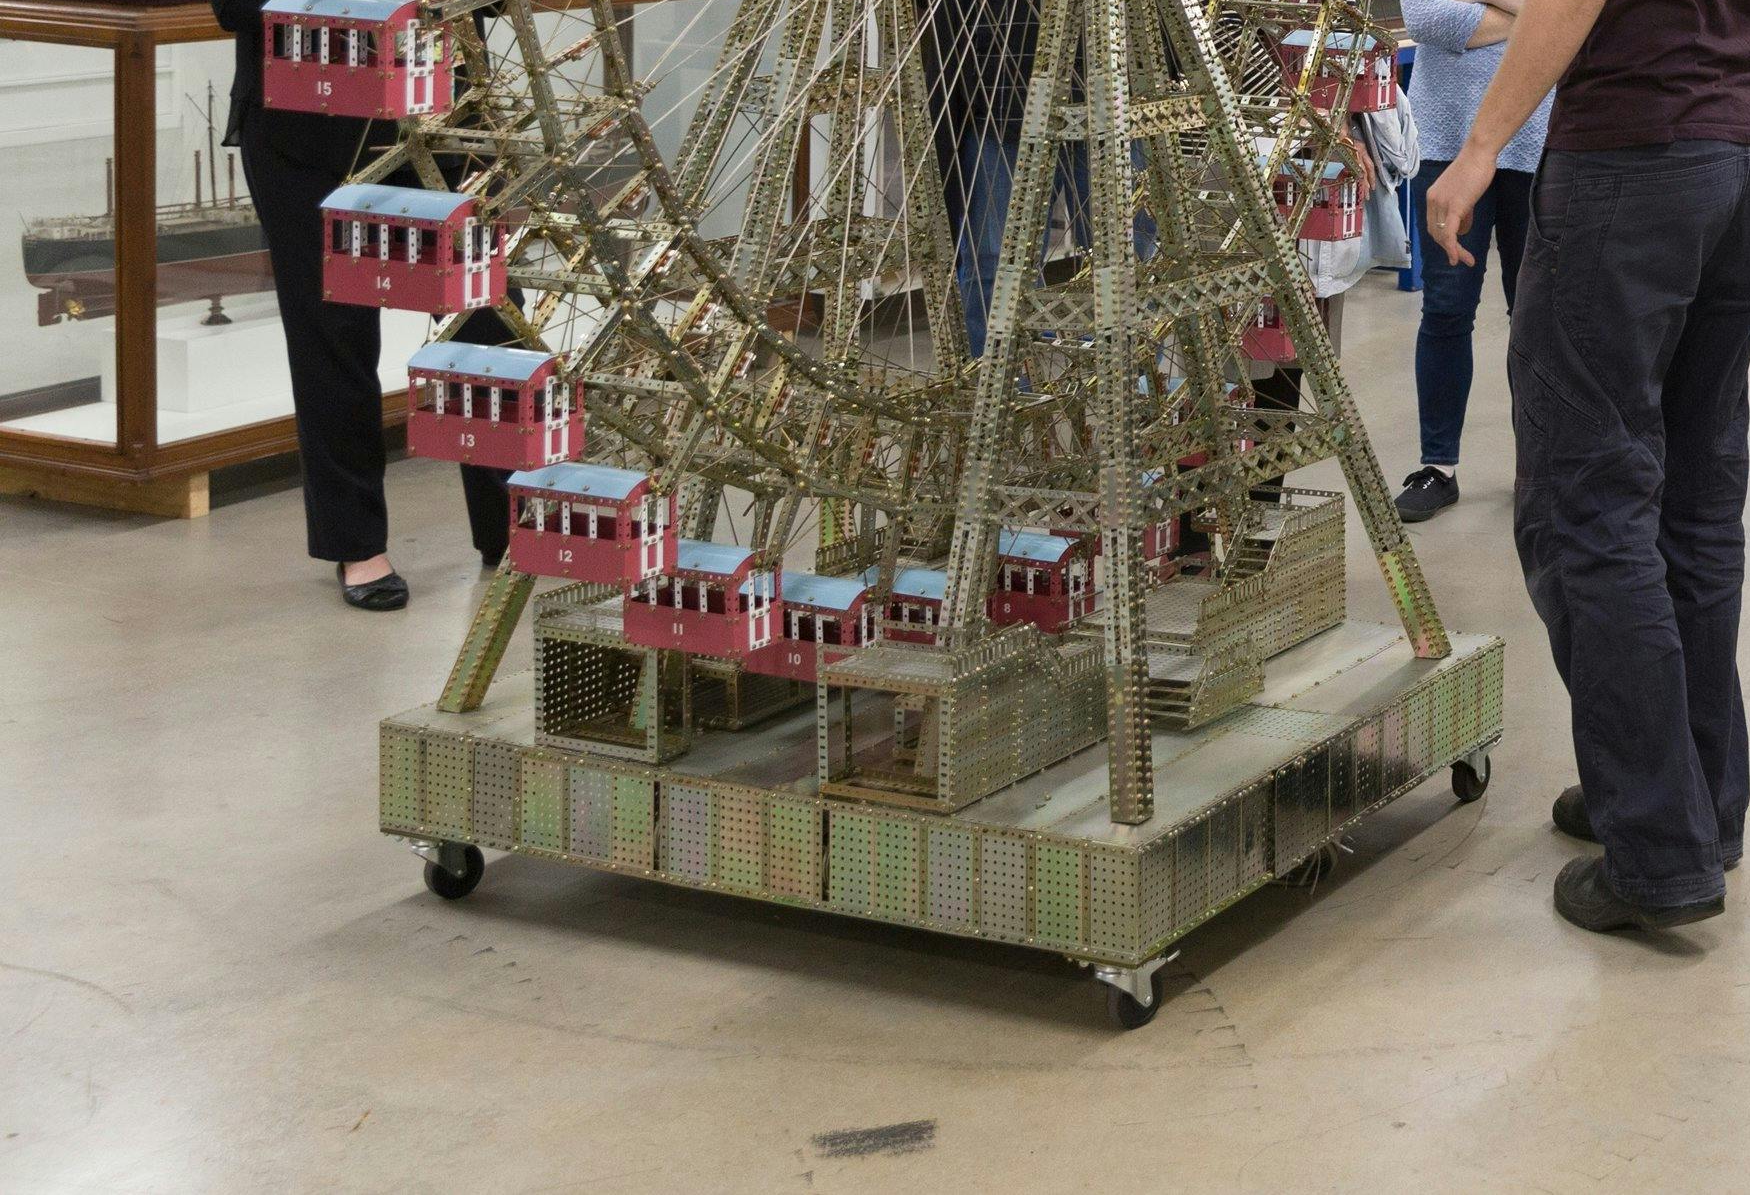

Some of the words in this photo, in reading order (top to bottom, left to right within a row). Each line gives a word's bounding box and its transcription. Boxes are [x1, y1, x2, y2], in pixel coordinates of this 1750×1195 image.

[317, 81, 333, 95] 15
[377, 276, 392, 290] 14
[461, 433, 476, 447] 13
[559, 549, 573, 562] 12
[1004, 603, 1012, 613] 8
[673, 622, 684, 635] 11
[788, 653, 802, 665] 10
